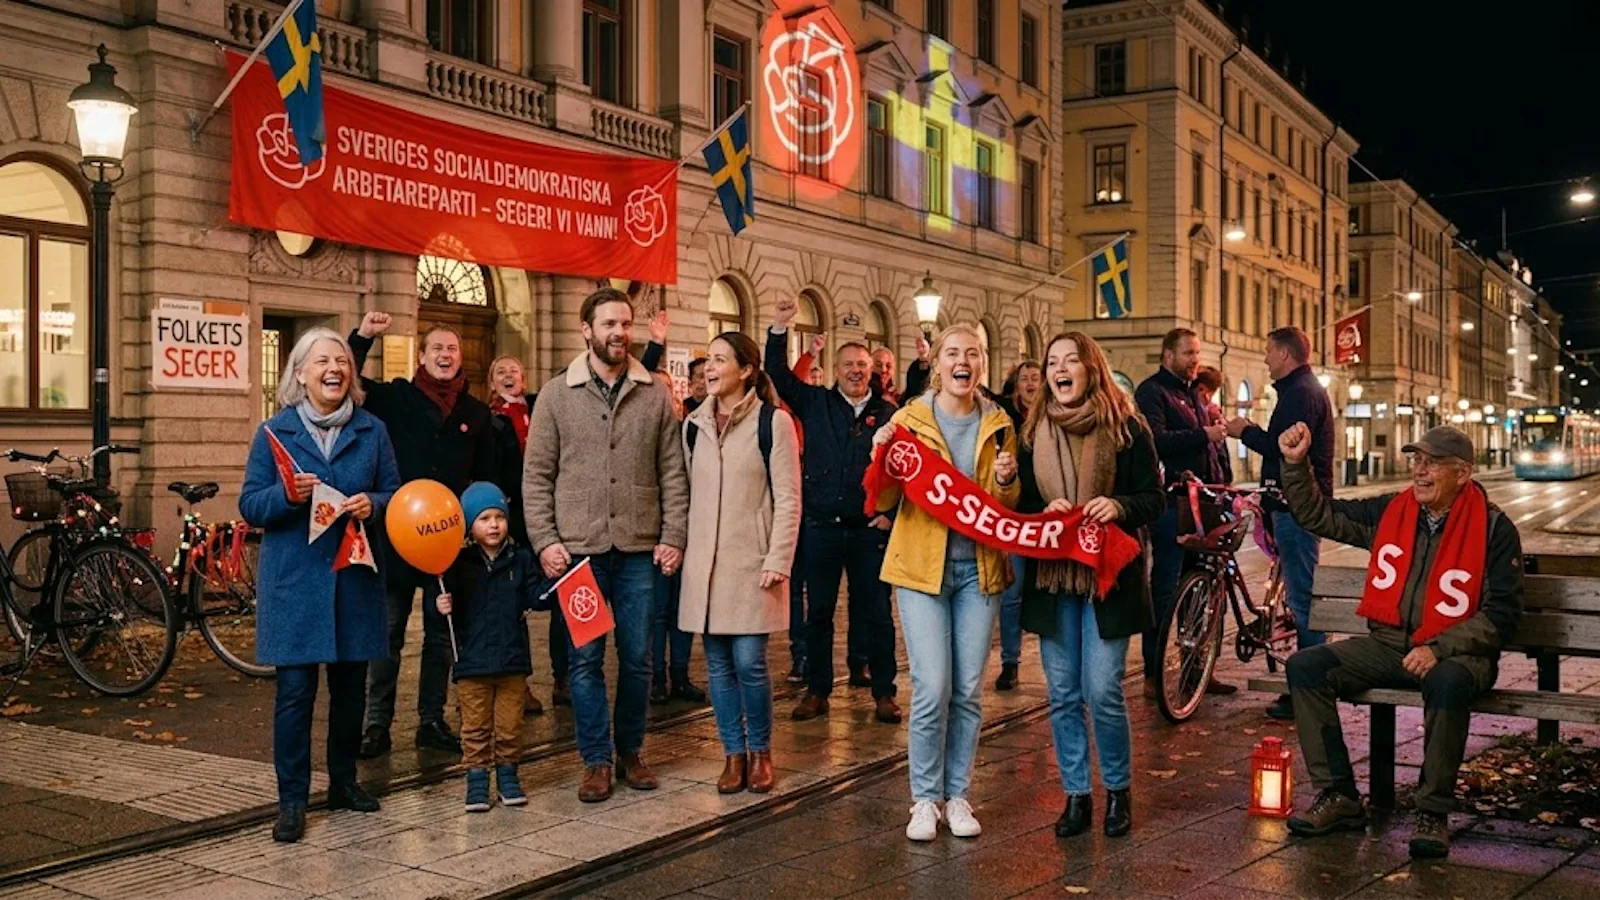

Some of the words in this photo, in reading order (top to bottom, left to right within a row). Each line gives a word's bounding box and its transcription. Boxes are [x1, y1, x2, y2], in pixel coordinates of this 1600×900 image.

[337, 126, 429, 171] SVERIGES
[433, 148, 612, 206] SOCIALDEMOKRATISKA
[332, 165, 477, 218] ARBETAREPARTI
[495, 197, 552, 231] SEGER!
[556, 208, 572, 233] VI
[575, 211, 618, 241] VANN!
[157, 317, 243, 347] FOLKETS
[162, 347, 239, 379] SEGER
[925, 472, 1064, 549] S-SEGER
[1371, 543, 1404, 590] S
[1434, 568, 1473, 618] S
